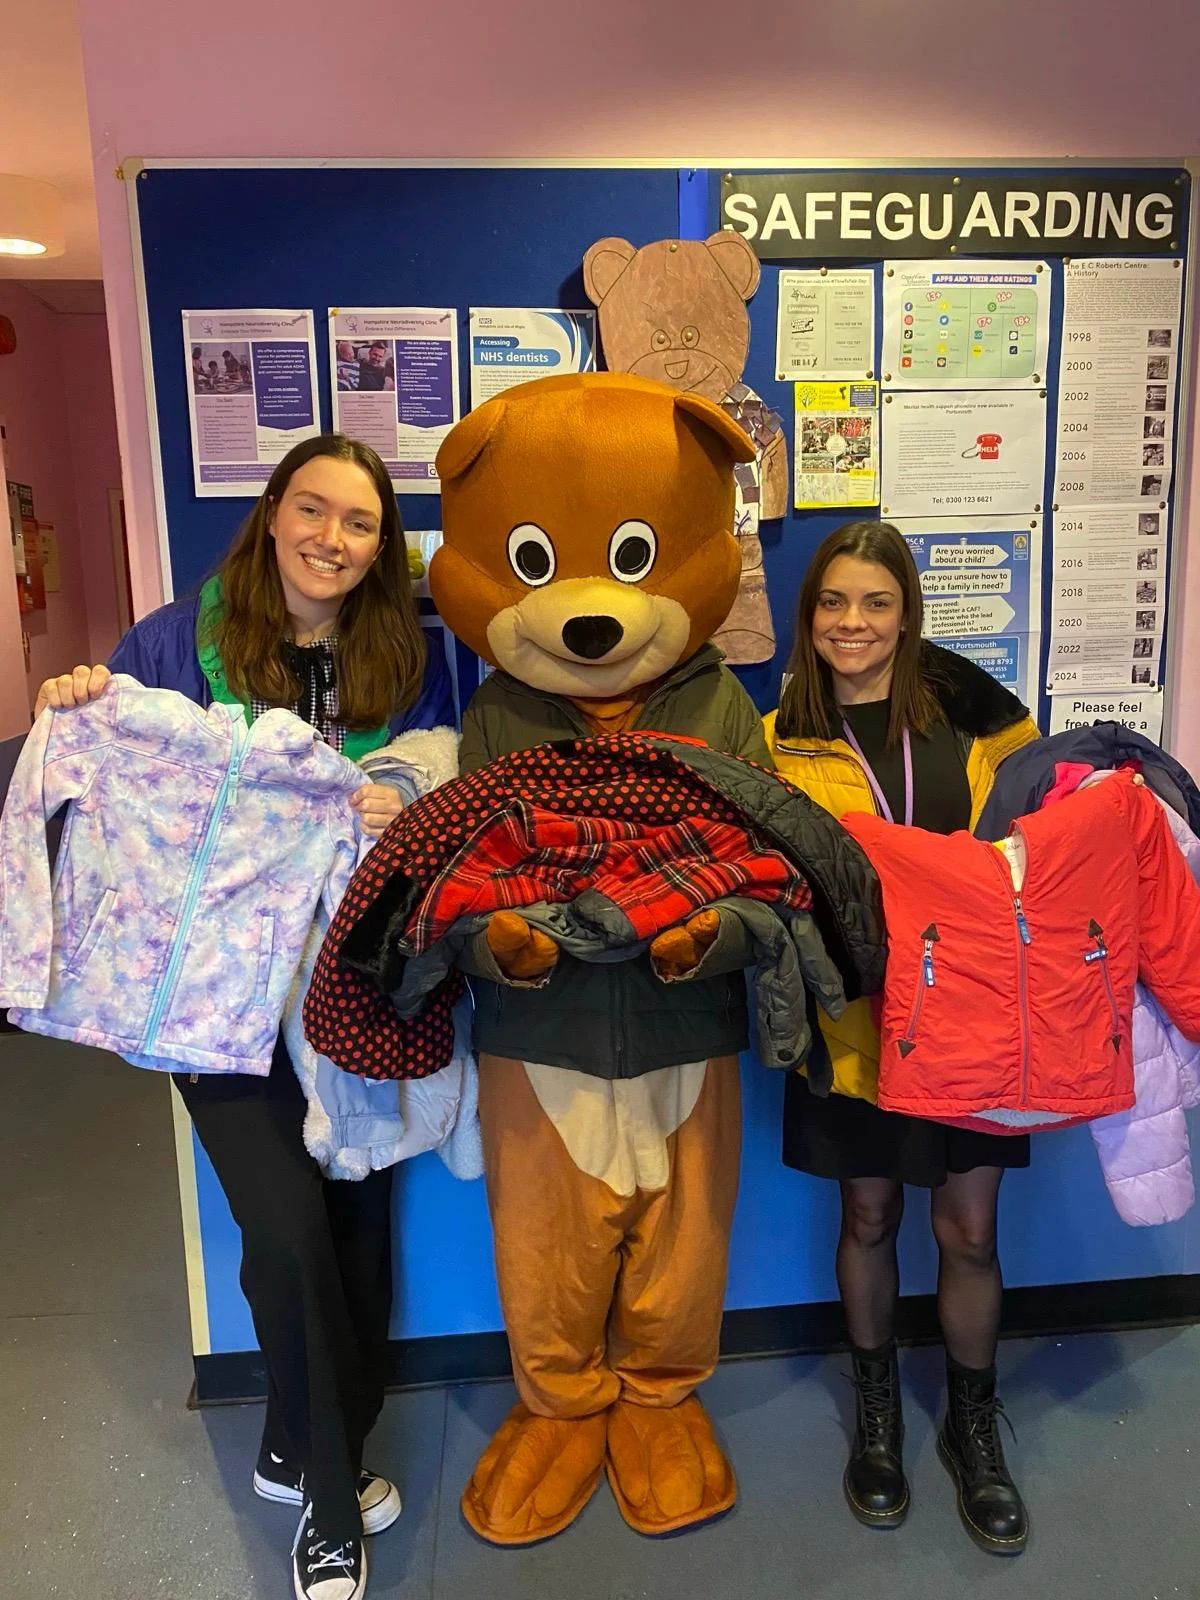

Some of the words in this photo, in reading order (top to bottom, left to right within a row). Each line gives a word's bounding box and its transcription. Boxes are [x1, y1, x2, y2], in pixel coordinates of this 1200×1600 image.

[723, 191, 1174, 240] SAFEGUARDING
[926, 291, 941, 302] 13+
[996, 291, 1012, 302] 16+
[977, 317, 992, 328] 17+
[1014, 316, 1030, 327] 18+
[1068, 332, 1092, 342] 1998
[480, 339, 511, 347] Accessing
[480, 352, 503, 362] NHS
[506, 352, 549, 362] dentists
[1066, 362, 1092, 371] 2000
[1064, 392, 1089, 401] 2002
[1063, 424, 1088, 432] 2004
[1062, 452, 1086, 461] 2006
[1060, 482, 1084, 491] 2008
[1061, 522, 1083, 531] 2014
[1061, 559, 1083, 568] 2016
[1061, 588, 1083, 597] 2018
[1059, 618, 1082, 627] 2020
[956, 641, 997, 649] Portsmouth
[1057, 645, 1081, 654] 2022
[1054, 672, 1077, 681] 2024
[1073, 702, 1115, 712] Please
[1118, 702, 1142, 712] feel
[1065, 719, 1090, 729] free
[1140, 721, 1148, 729] a
